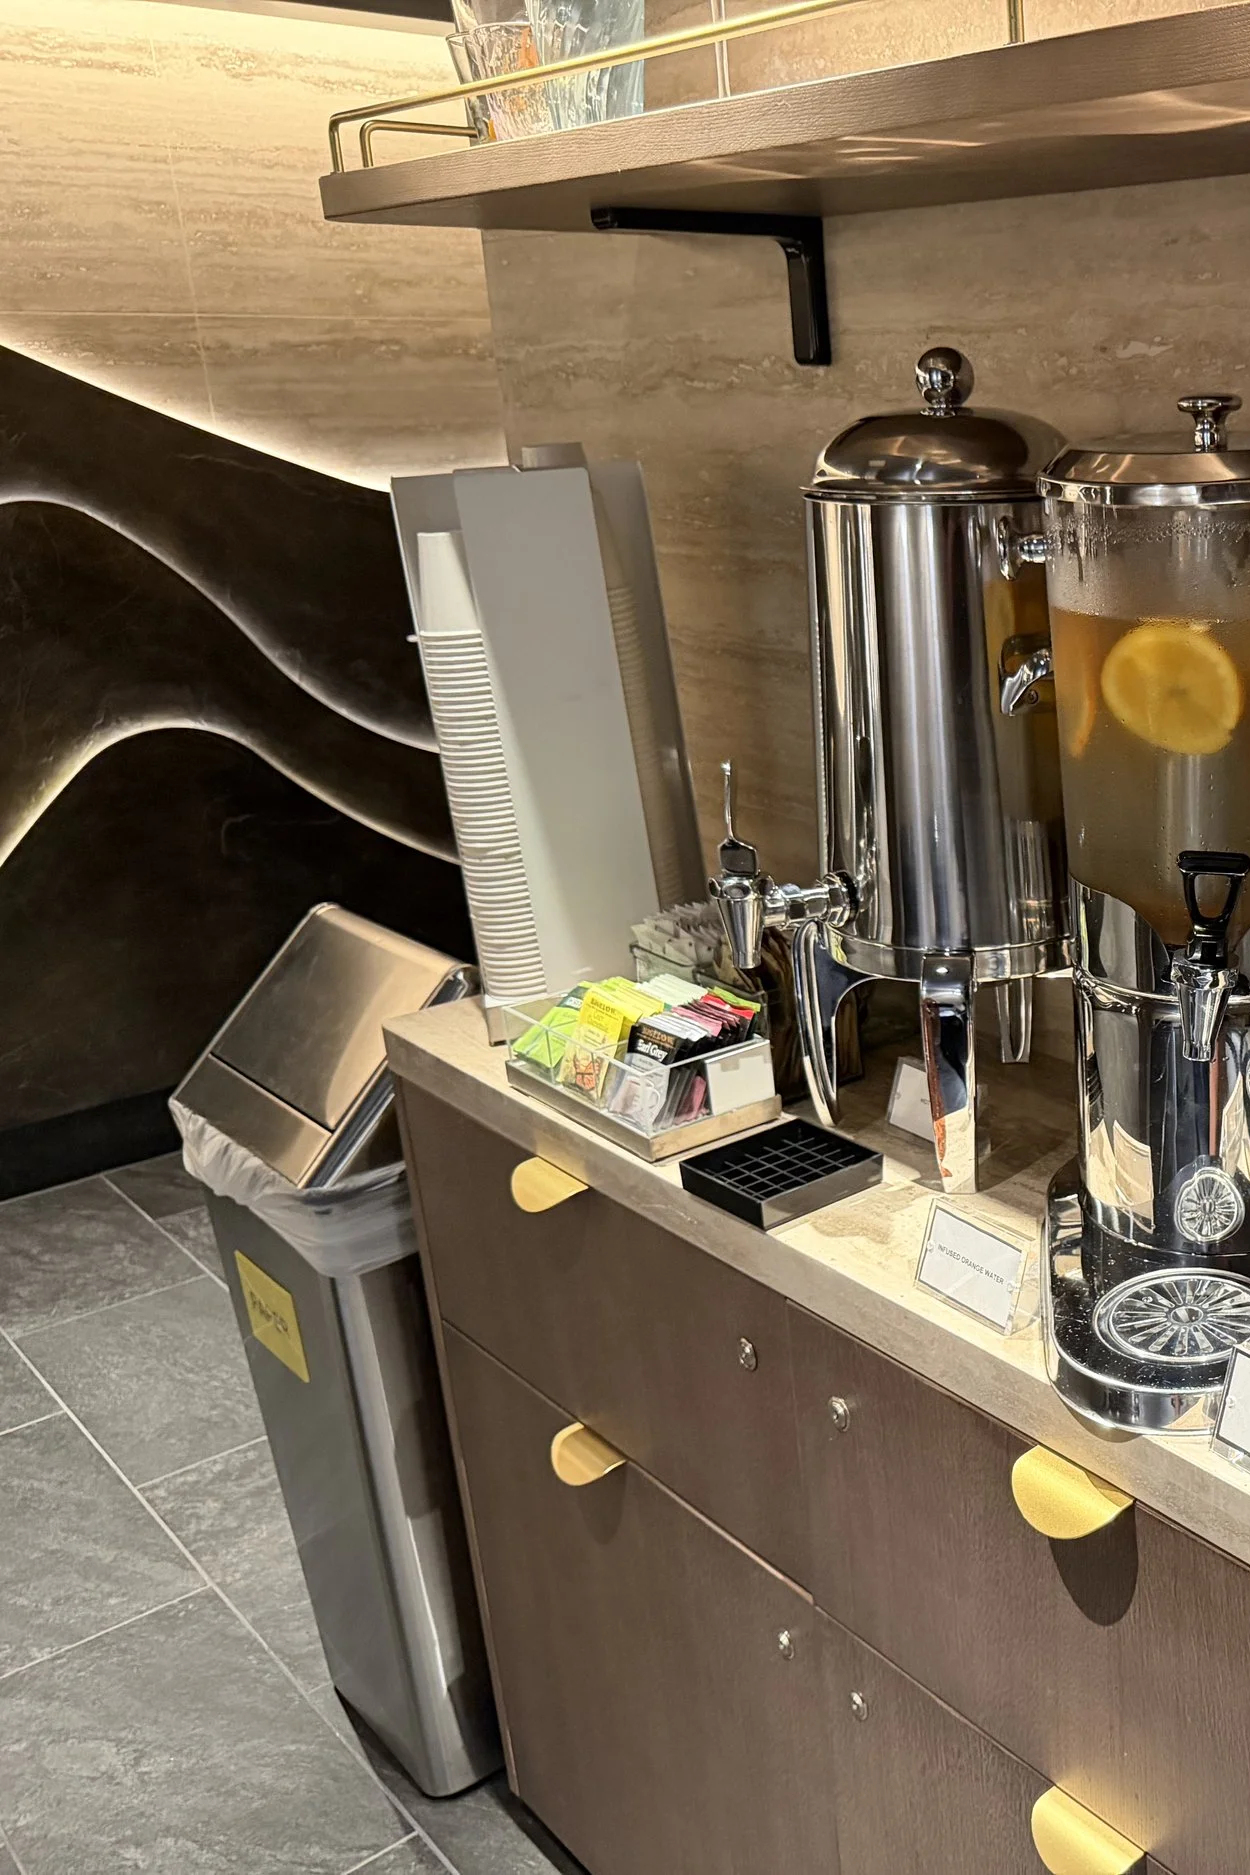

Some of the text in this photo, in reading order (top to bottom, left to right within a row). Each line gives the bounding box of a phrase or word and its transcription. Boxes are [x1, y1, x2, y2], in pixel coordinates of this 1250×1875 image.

[637, 1039, 650, 1054] Earl
[650, 1044, 668, 1062] Grey
[938, 1244, 1004, 1285] INFUSED ORANGE WATER
